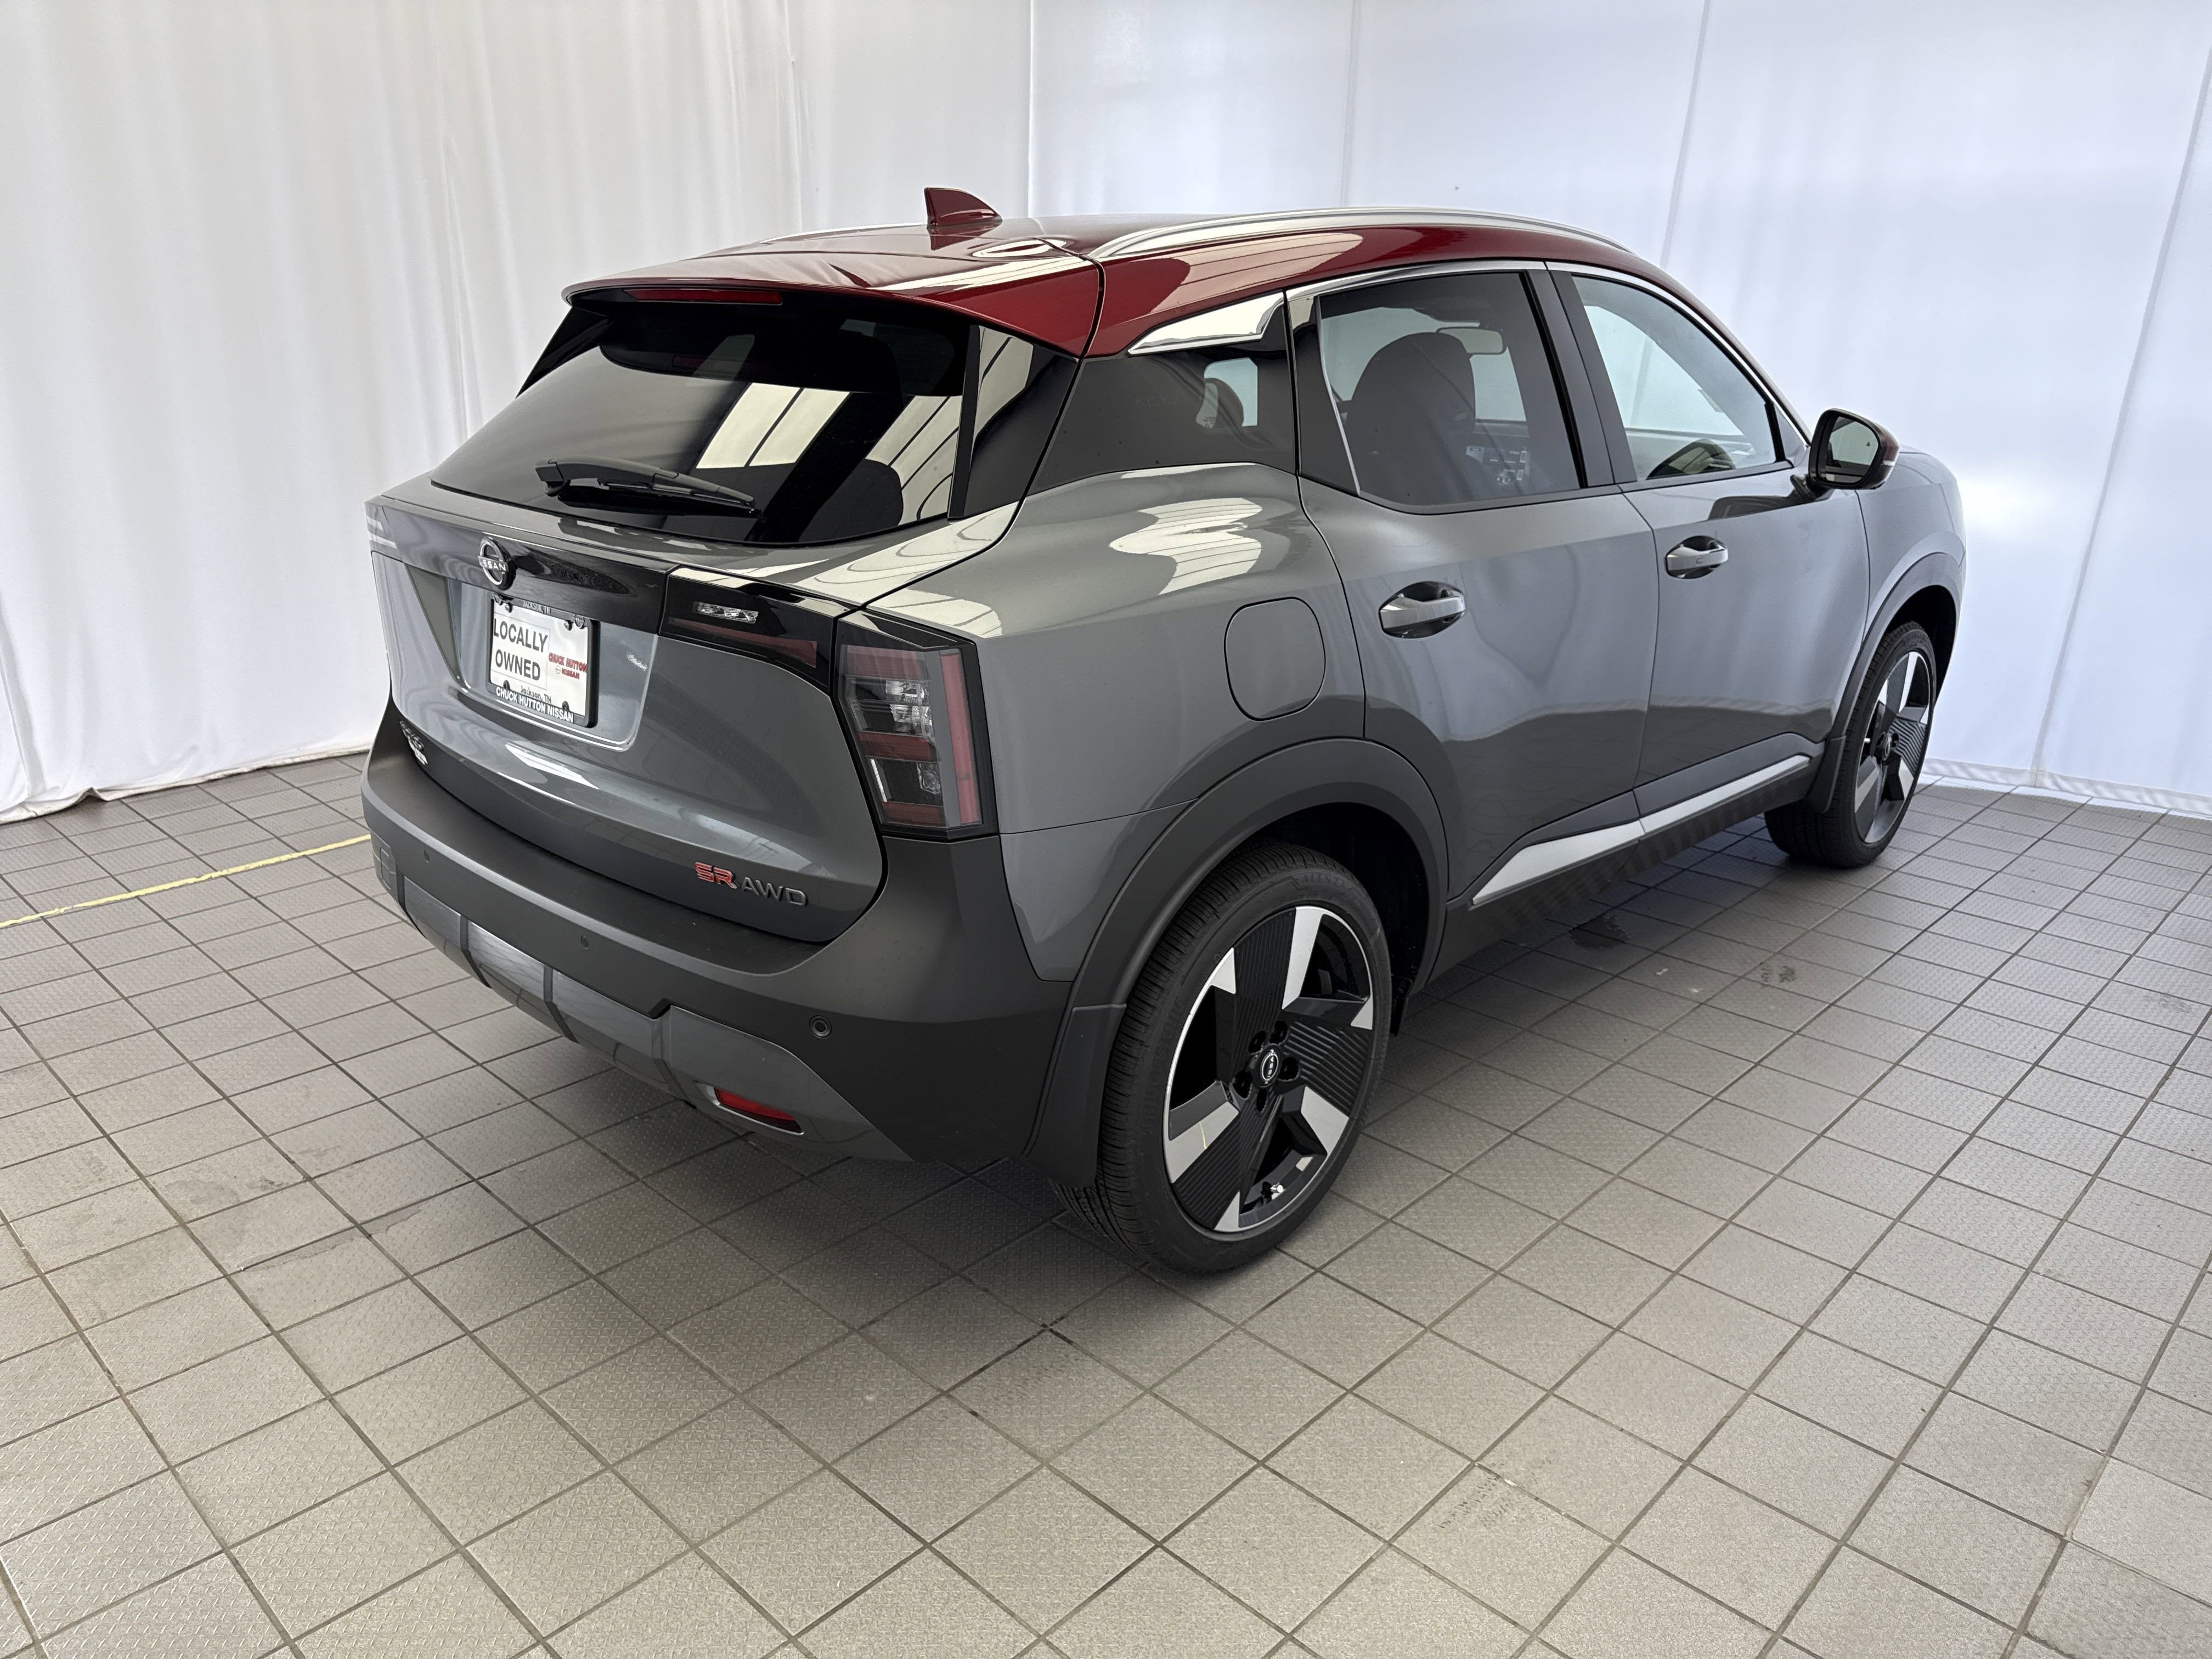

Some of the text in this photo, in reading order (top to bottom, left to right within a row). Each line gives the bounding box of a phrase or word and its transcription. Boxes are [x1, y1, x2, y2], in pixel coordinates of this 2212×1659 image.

[481, 559, 507, 572] SSAN
[494, 618, 548, 652] LOCALLY
[495, 649, 540, 680] OWNED
[549, 652, 565, 666] CHUCK
[496, 687, 573, 723] CHUCK HUTTON NISSAN
[544, 694, 551, 703] TN
[694, 862, 808, 907] SR AWD
